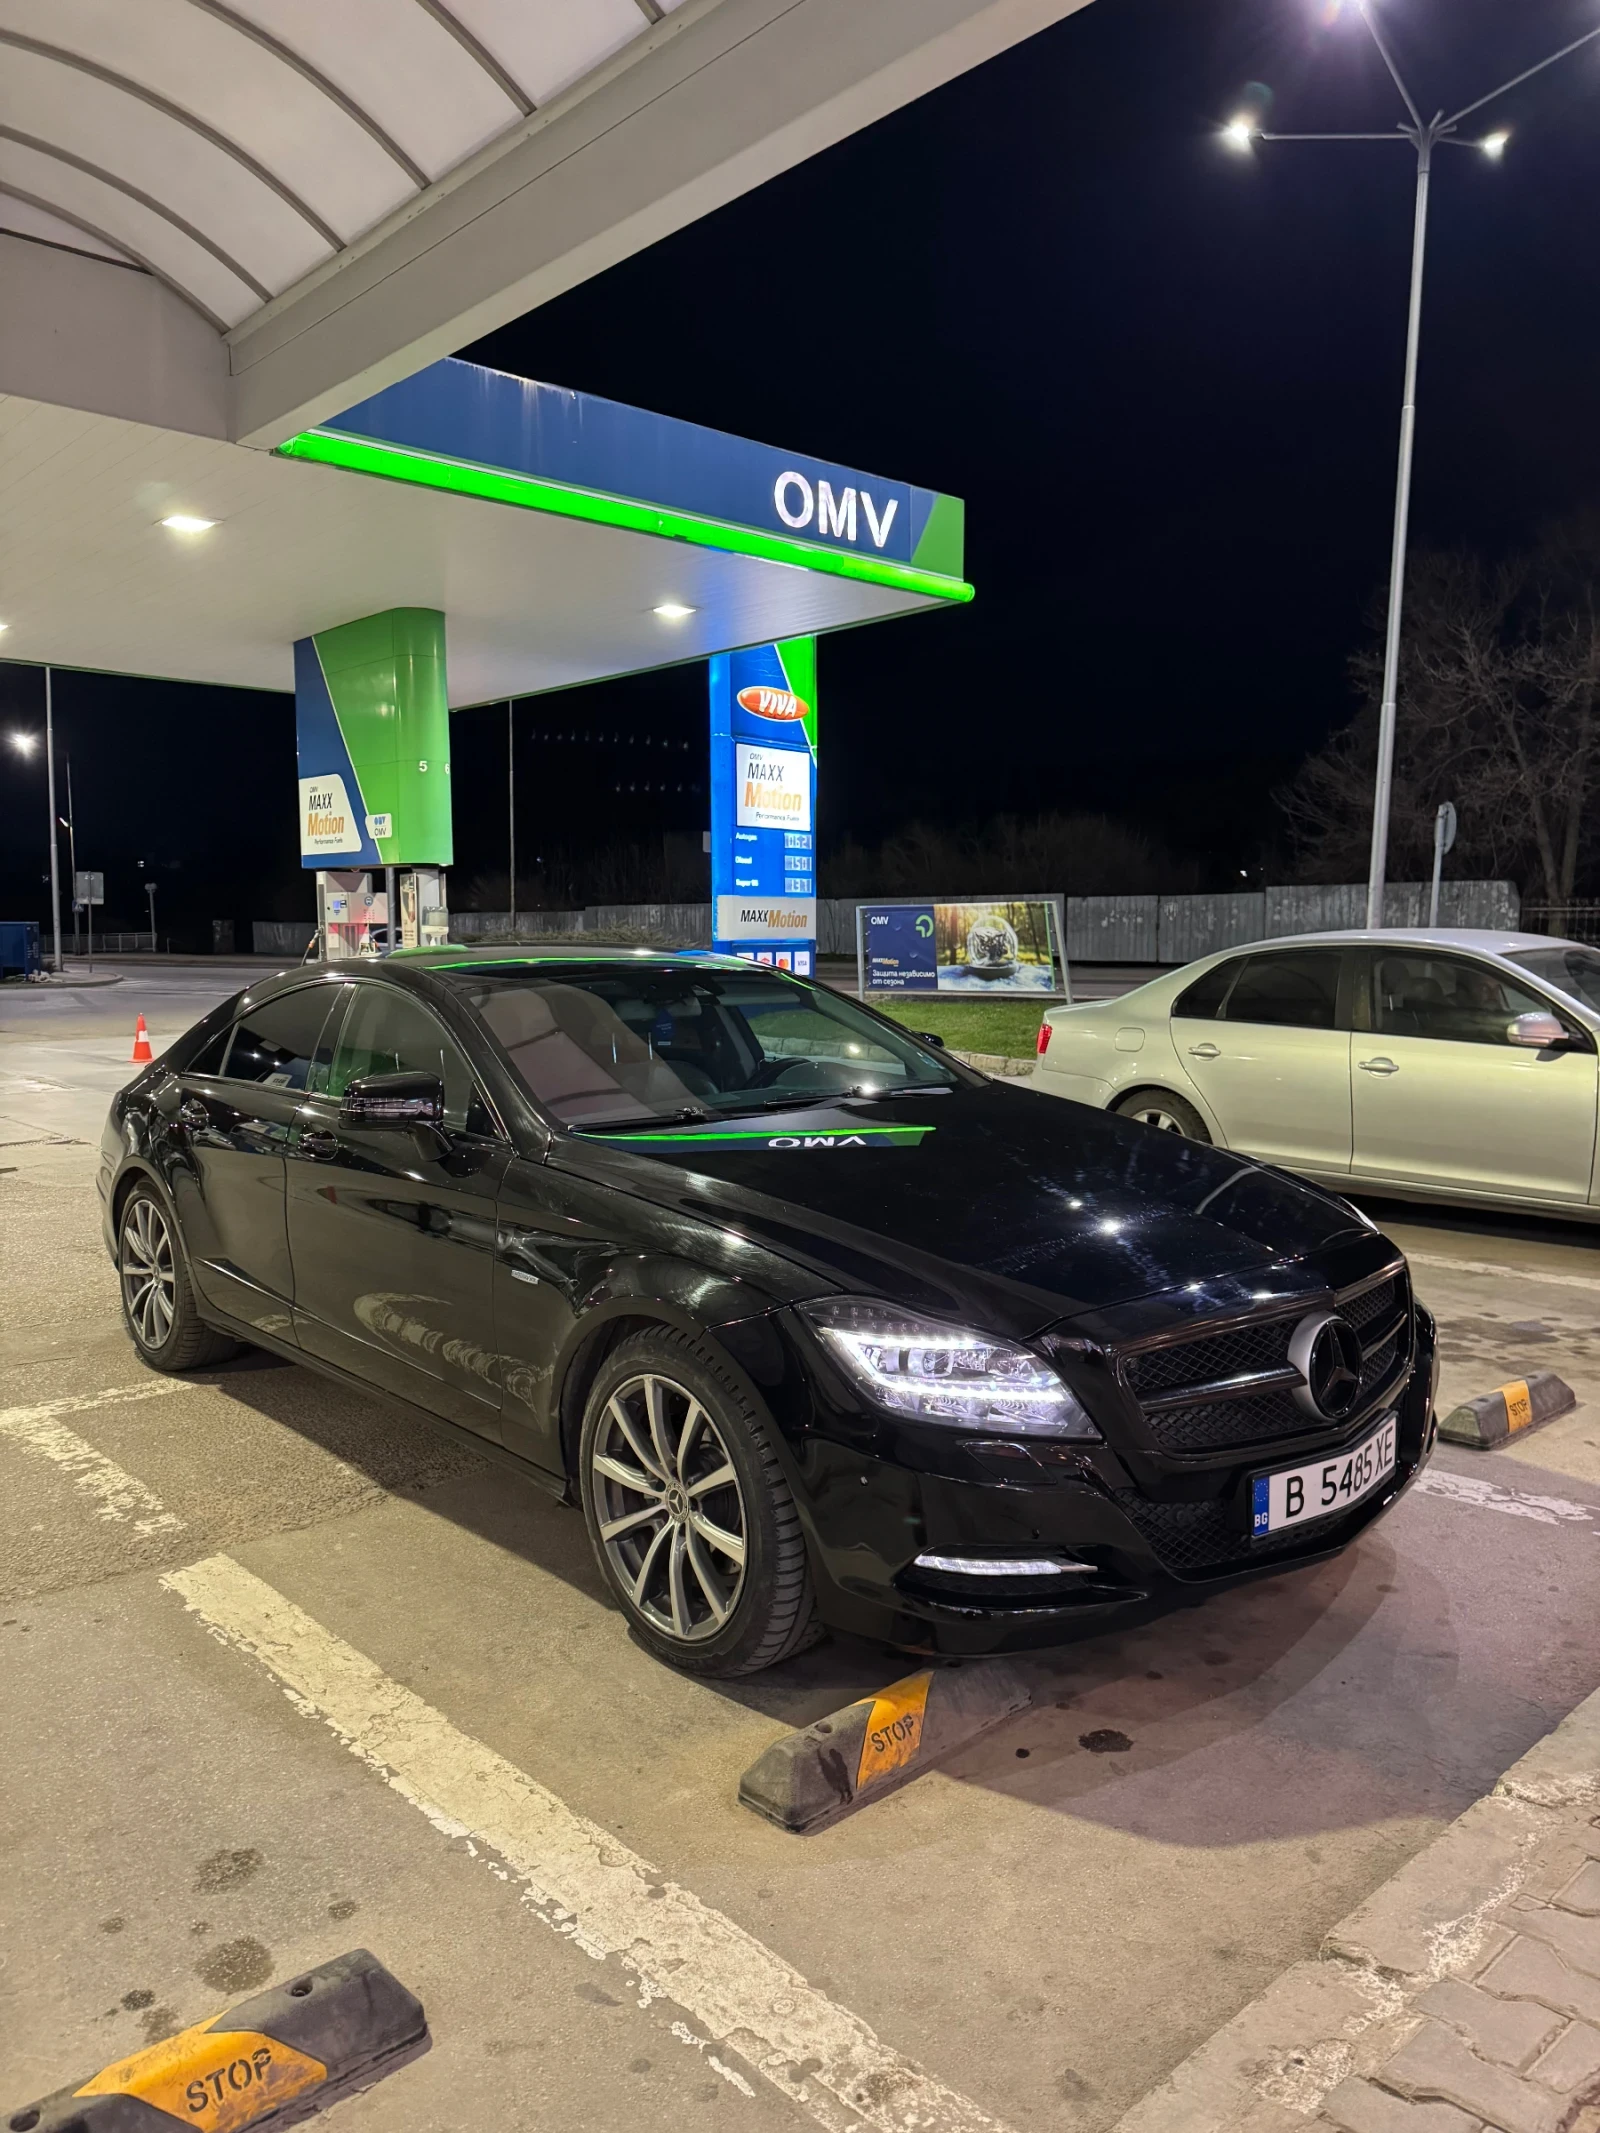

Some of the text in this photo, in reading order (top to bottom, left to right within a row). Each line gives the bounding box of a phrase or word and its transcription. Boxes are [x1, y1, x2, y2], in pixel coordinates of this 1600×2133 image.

[774, 471, 898, 547] OMV
[759, 690, 797, 718] VIVA
[419, 760, 428, 772] 5
[444, 763, 450, 774] 6
[747, 762, 785, 782] MAXX
[308, 793, 333, 811] MAXX
[744, 781, 802, 812] Motion
[307, 811, 345, 836] Motion
[374, 828, 387, 836] OMV
[871, 916, 889, 925] OMV
[872, 969, 936, 979] Защита независимо
[1509, 1398, 1527, 1416] STOP
[1286, 1426, 1394, 1518] B 5485 XE
[1254, 1512, 1268, 1527] BG
[871, 1713, 914, 1753] STOP
[186, 2048, 272, 2113] STOP
